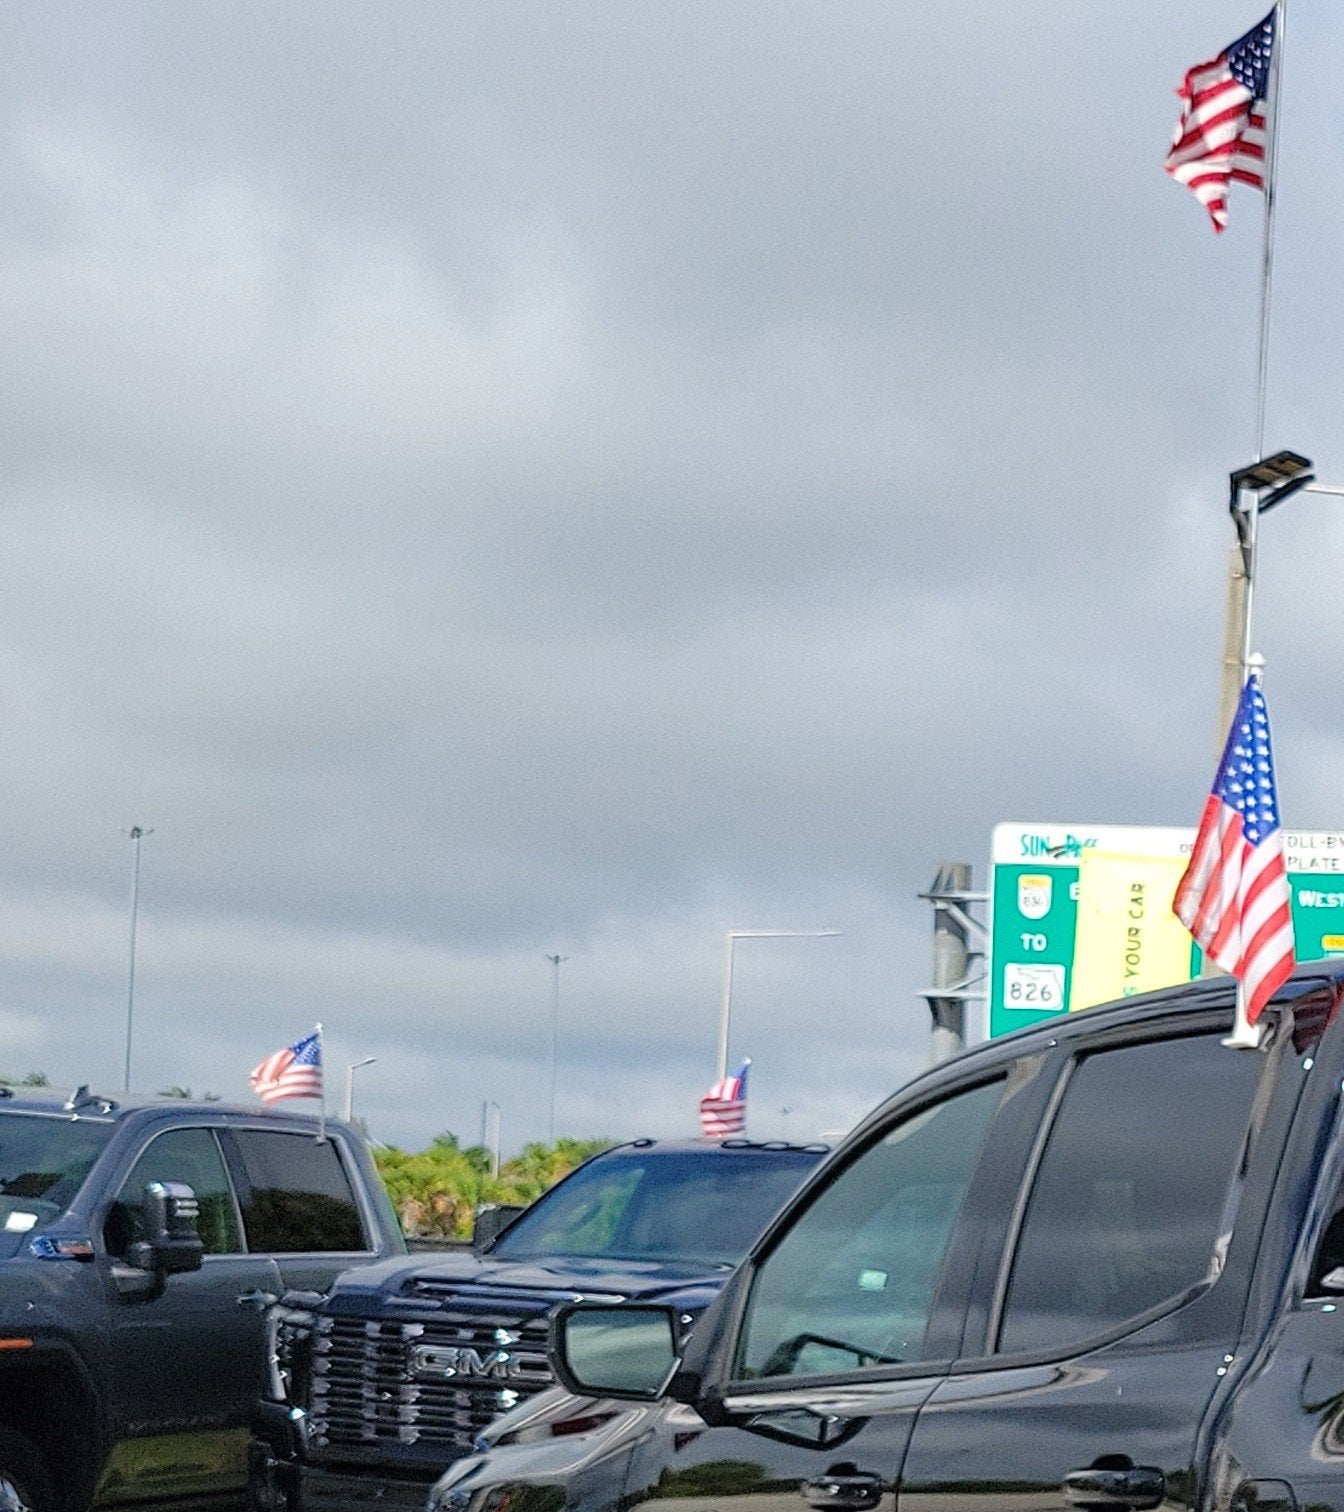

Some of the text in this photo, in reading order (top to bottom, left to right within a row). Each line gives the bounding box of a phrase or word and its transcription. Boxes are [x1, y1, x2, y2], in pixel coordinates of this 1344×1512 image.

[1287, 856, 1340, 871] PLATE
[1129, 882, 1145, 920] CAR
[1019, 932, 1047, 952] TO
[1124, 926, 1142, 979] YOUR
[1010, 981, 1053, 1002] 826
[415, 1344, 553, 1381] GMC
